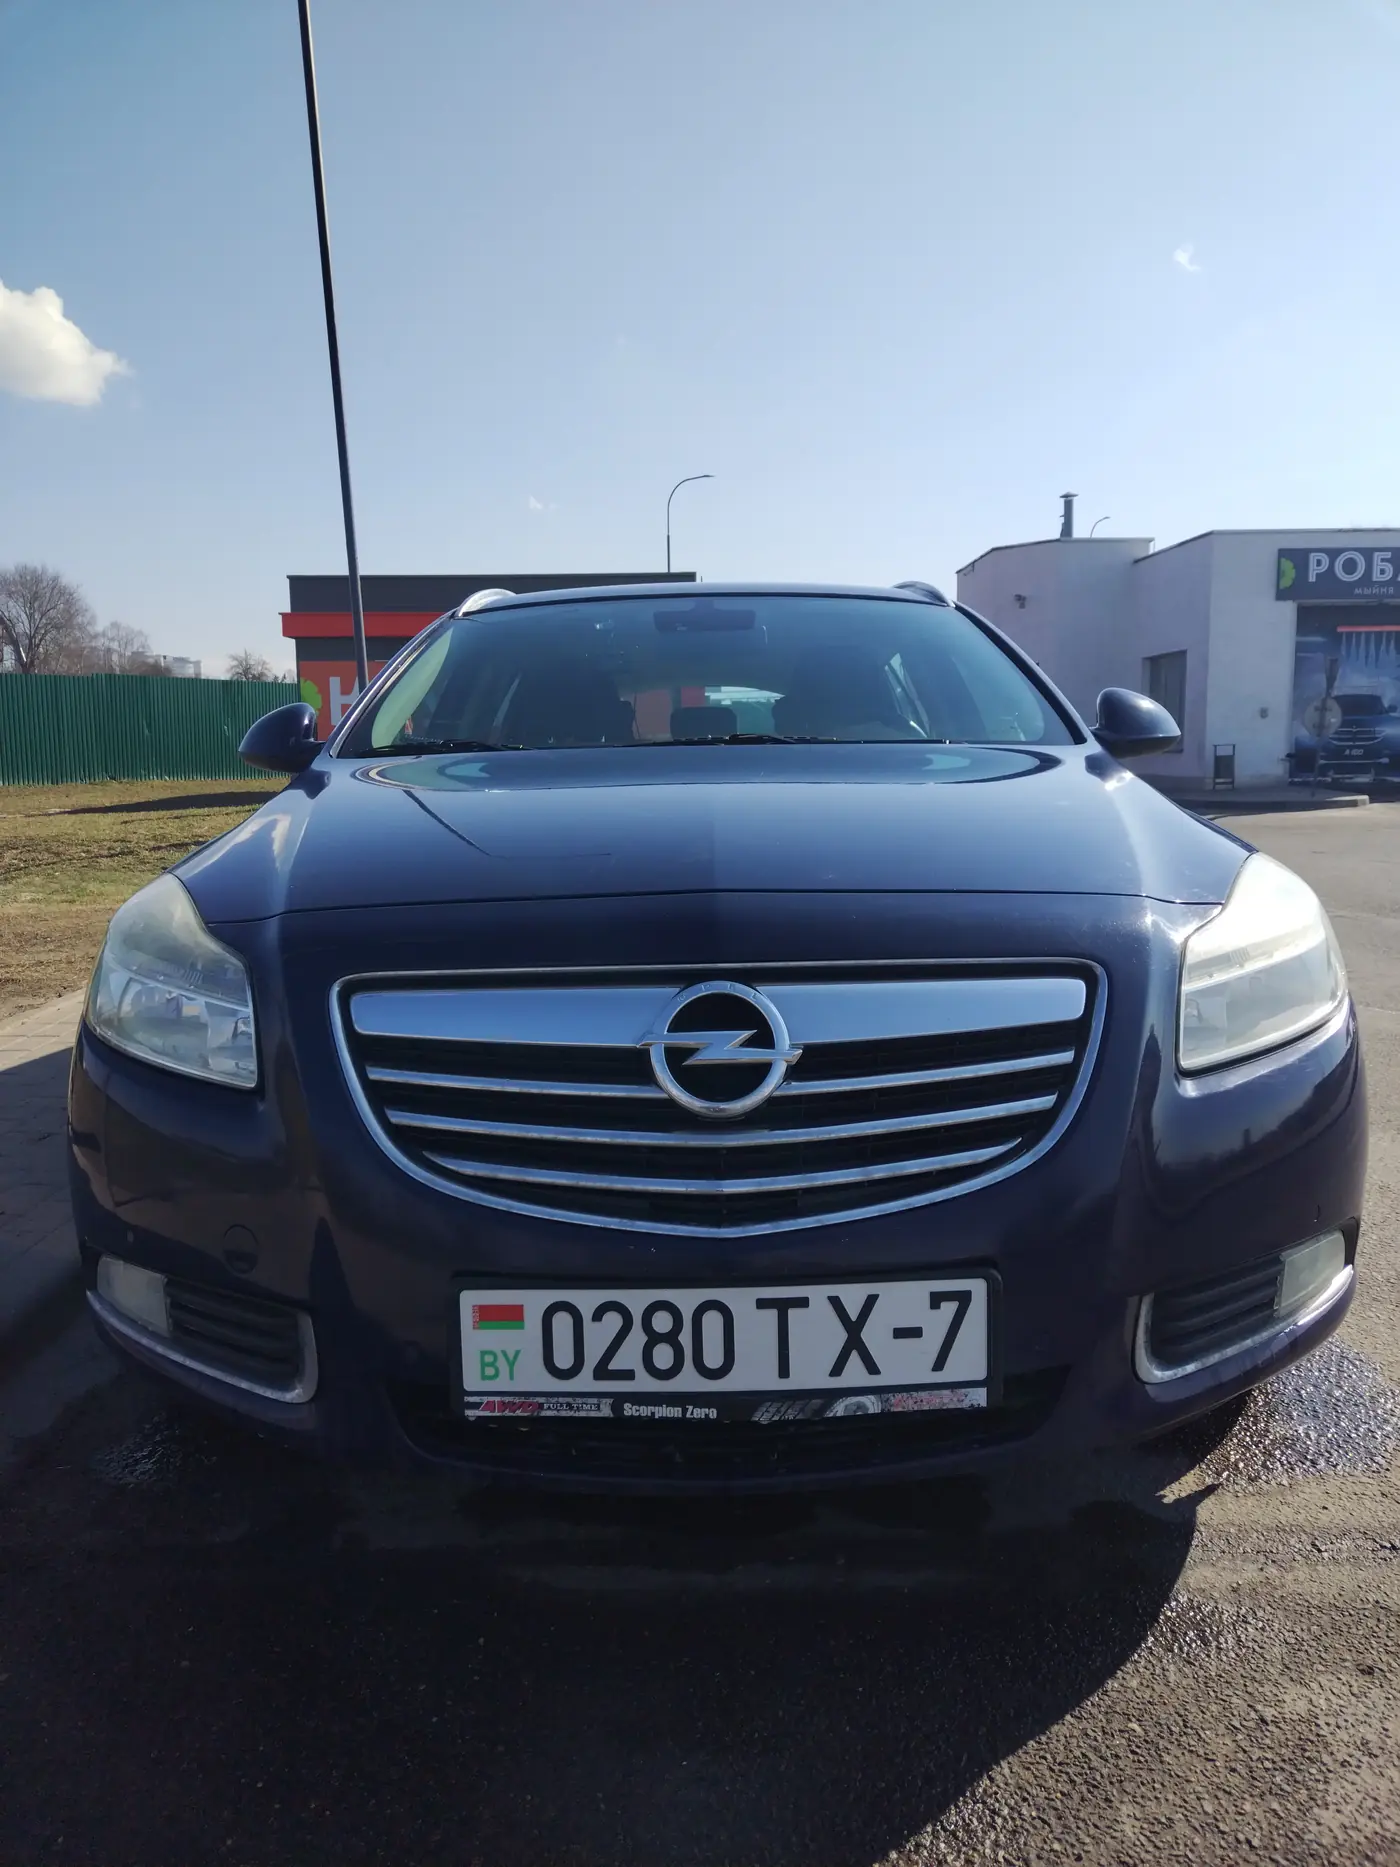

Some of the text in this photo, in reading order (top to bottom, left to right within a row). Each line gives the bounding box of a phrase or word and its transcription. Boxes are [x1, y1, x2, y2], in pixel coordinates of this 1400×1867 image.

[1308, 551, 1400, 582] РОБ
[541, 1299, 735, 1381] 0280
[479, 1349, 522, 1381] BY
[478, 1399, 599, 1415] AWD FULL TIME
[623, 1403, 718, 1419] Scorpion Zero
